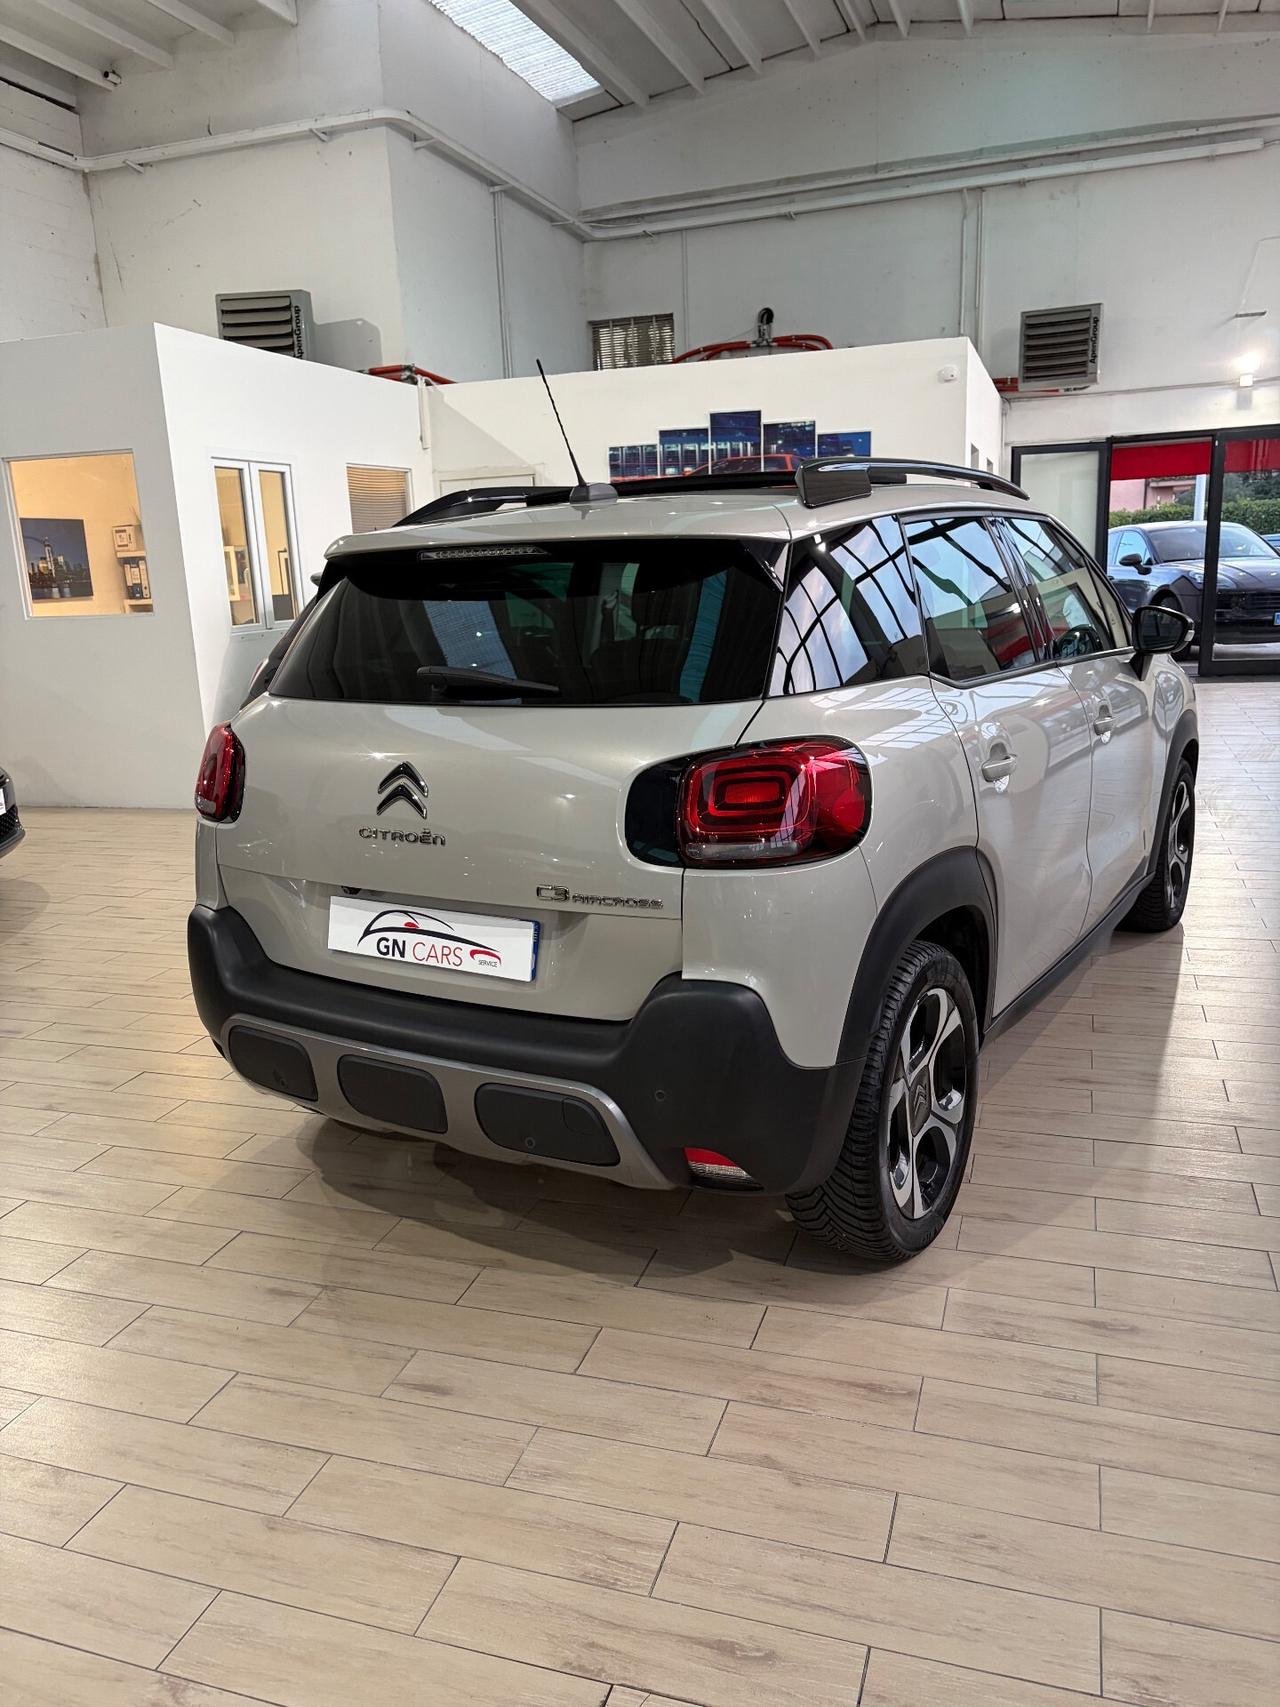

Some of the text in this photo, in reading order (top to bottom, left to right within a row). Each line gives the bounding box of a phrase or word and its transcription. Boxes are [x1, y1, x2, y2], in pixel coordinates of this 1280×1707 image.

[536, 884, 570, 901] C3
[376, 936, 463, 967] GN CARS
[478, 959, 498, 968] SERVICE
